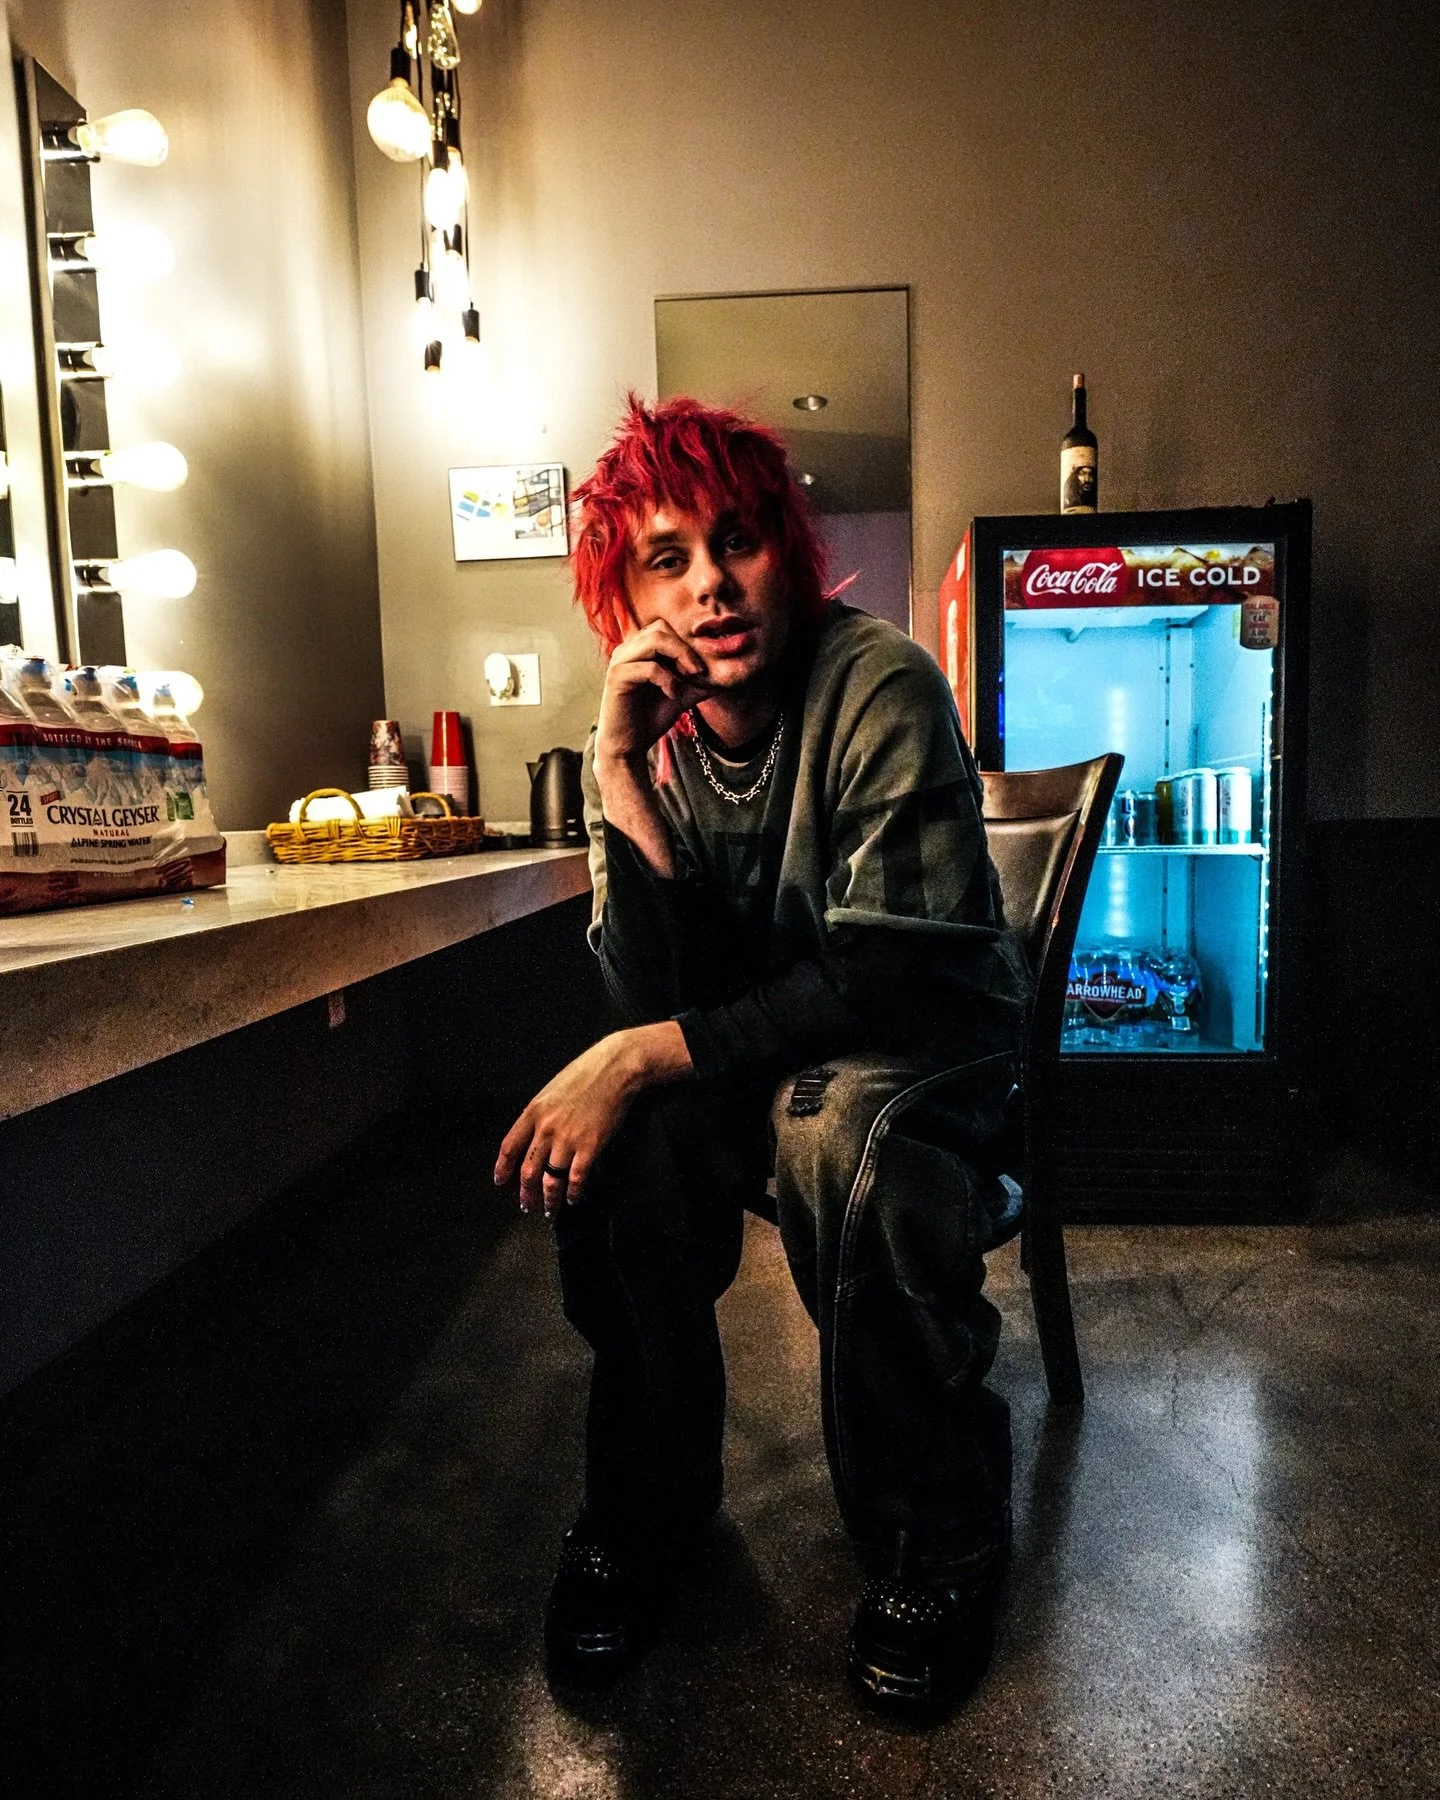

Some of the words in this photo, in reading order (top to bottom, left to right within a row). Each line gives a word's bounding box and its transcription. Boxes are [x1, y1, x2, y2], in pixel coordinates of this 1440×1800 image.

[1026, 562, 1123, 595] Coca-Cola
[1138, 568, 1180, 587] ICE
[1190, 566, 1260, 586] COLD
[43, 733, 82, 743] BOTTLED
[95, 737, 112, 746] THE
[8, 794, 32, 816] 24
[47, 805, 111, 828] CRYSTAL
[112, 806, 159, 827] GEYSER
[70, 837, 99, 848] ALPINE
[101, 840, 127, 849] SPRING
[128, 836, 152, 847] WATER
[93, 829, 130, 838] NATURAL
[1066, 983, 1142, 999] ARROWHEAD
